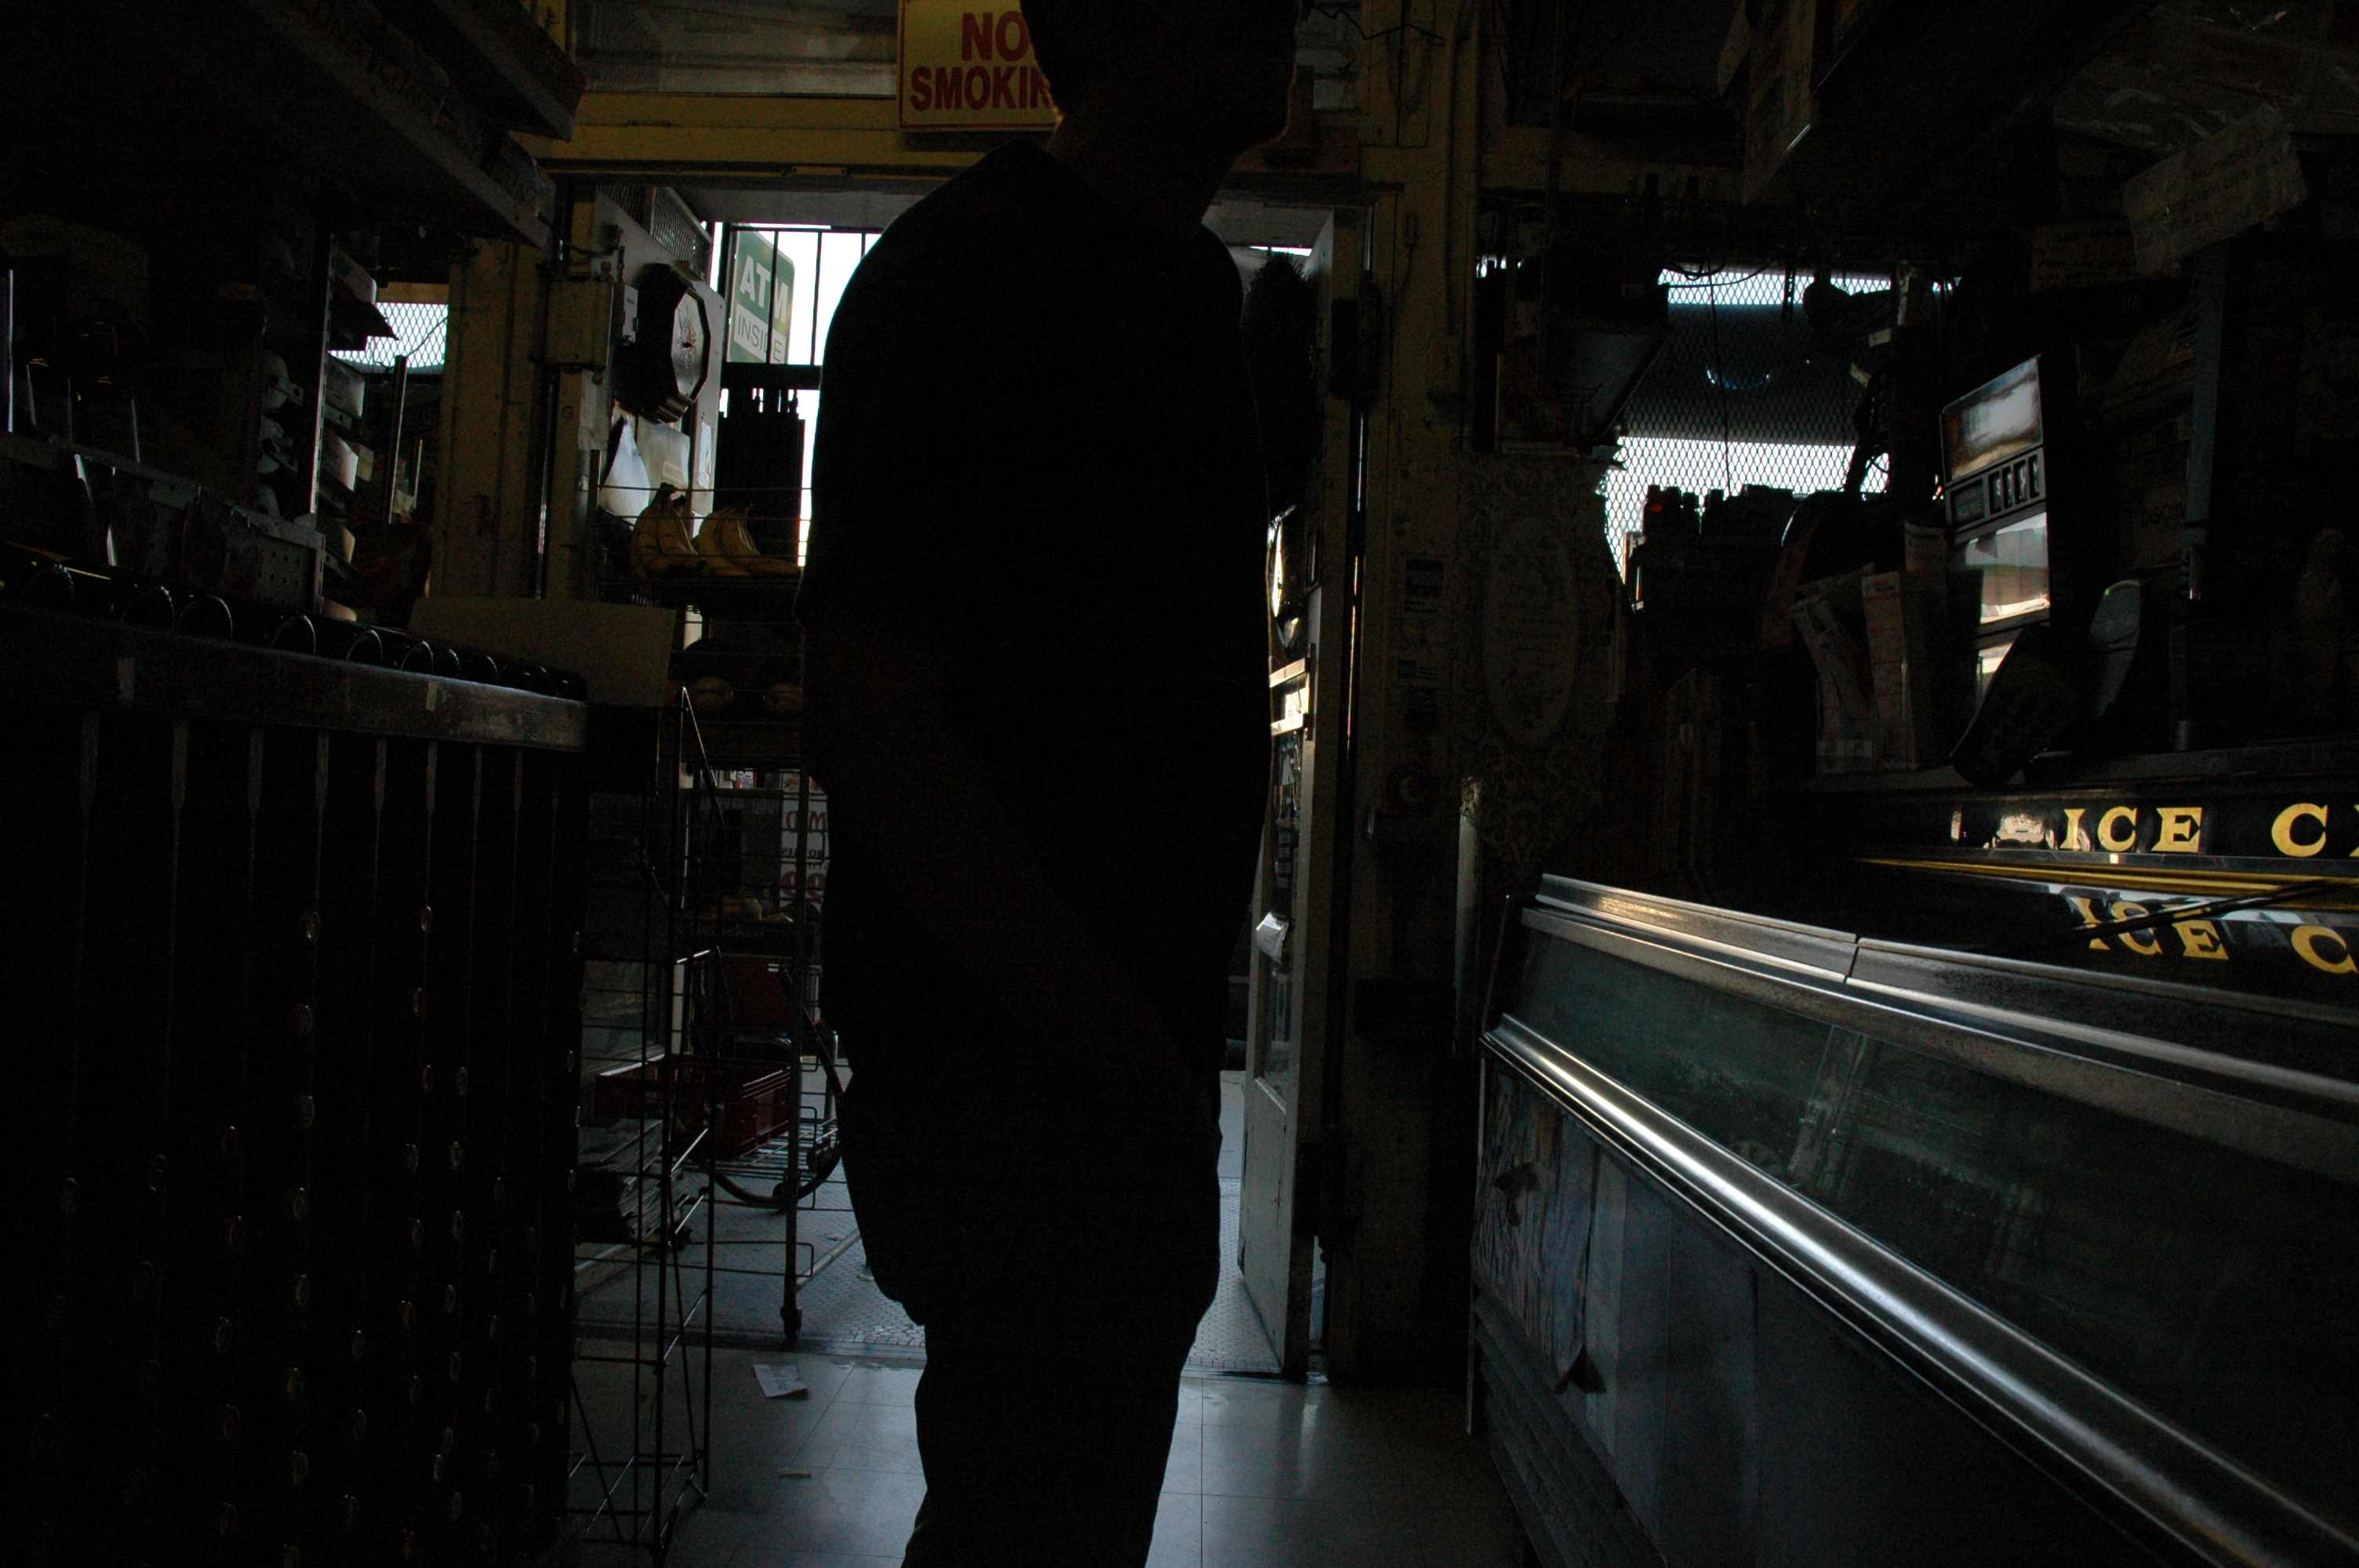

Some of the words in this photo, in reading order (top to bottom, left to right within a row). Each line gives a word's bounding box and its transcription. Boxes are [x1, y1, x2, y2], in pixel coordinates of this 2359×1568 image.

[961, 11, 1029, 62] NO
[910, 66, 1052, 111] SMOKIN
[739, 255, 789, 324] ATM
[2059, 806, 2204, 853] ICE
[2270, 802, 2359, 858] C
